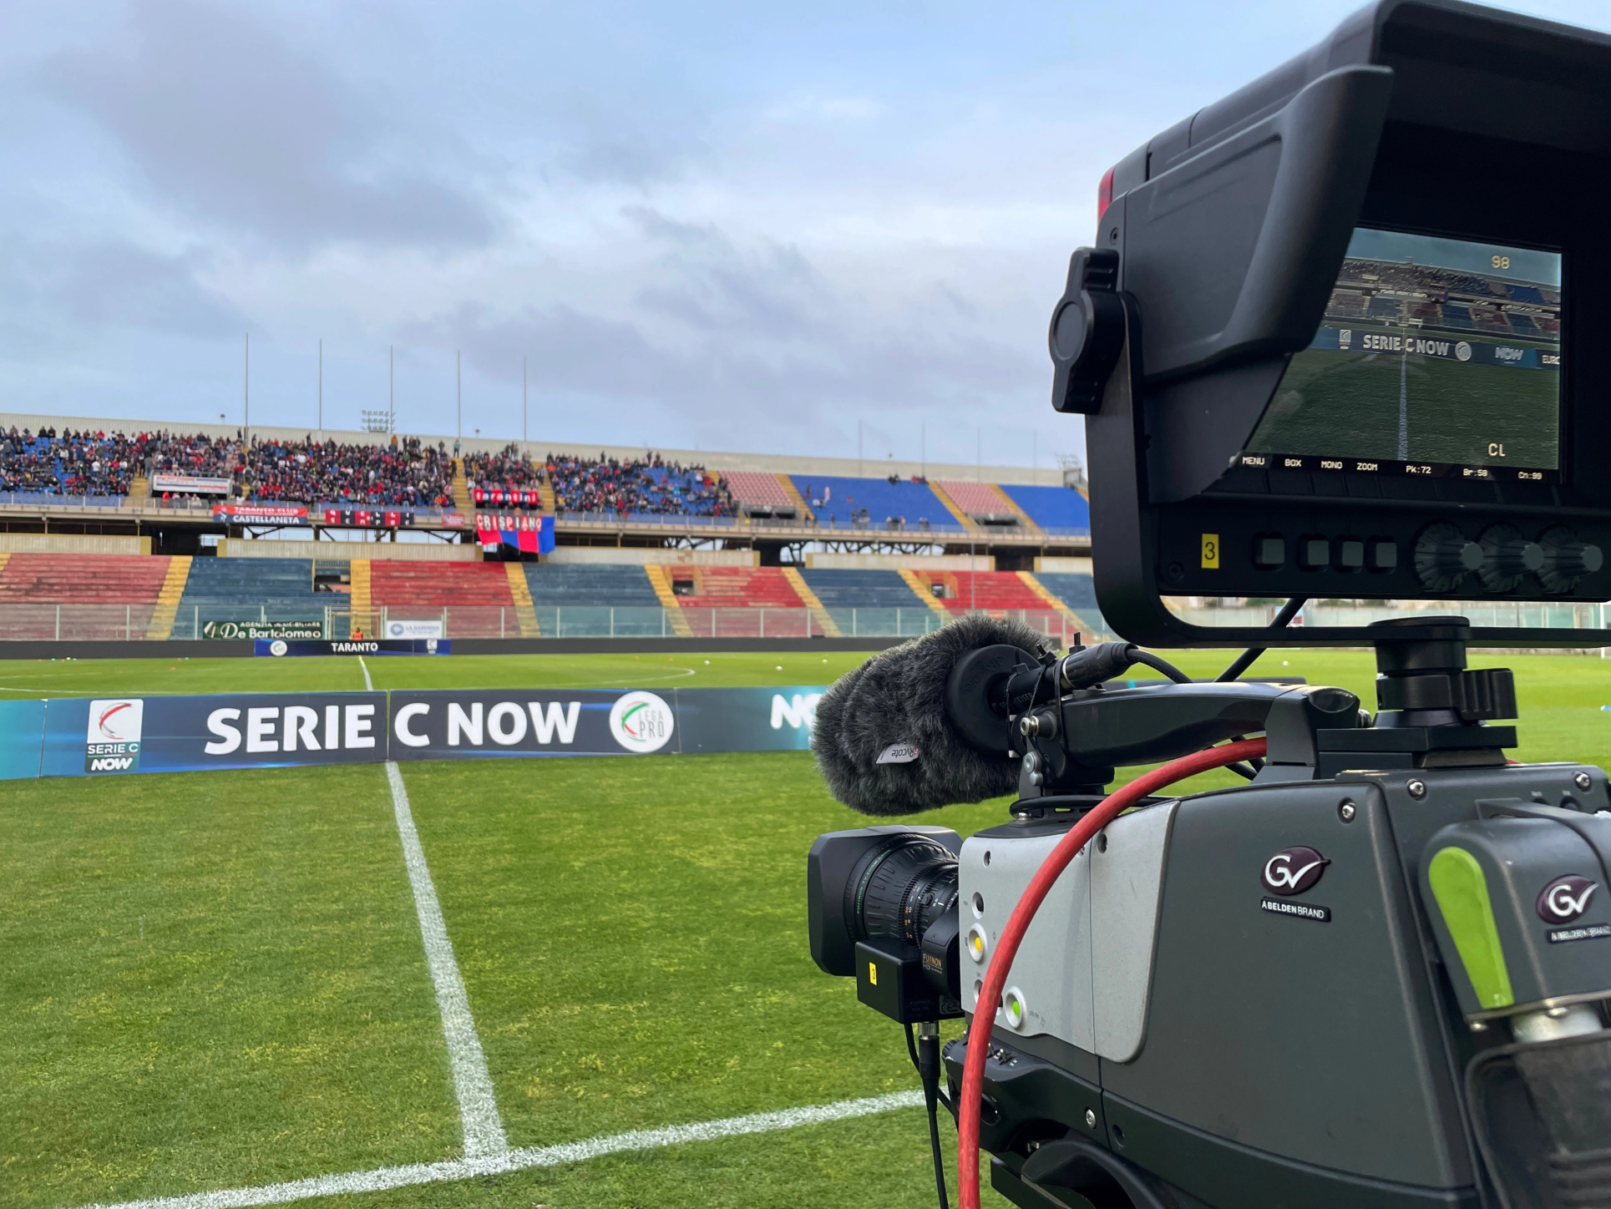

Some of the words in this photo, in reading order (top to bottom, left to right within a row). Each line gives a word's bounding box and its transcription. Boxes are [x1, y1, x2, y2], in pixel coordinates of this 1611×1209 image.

[1491, 255, 1510, 270] 98
[1363, 334, 1401, 351] SERIE
[1404, 338, 1415, 352] C
[1416, 339, 1450, 356] NOW
[1495, 346, 1524, 361] NOW
[1488, 443, 1506, 457] CL
[1242, 456, 1265, 466] MENU
[1284, 458, 1302, 467] BOX
[1321, 460, 1343, 470] MONO
[1357, 462, 1378, 472] ZOOM
[1406, 465, 1432, 475] Pk:72
[476, 492, 536, 503] tarantini
[232, 515, 300, 524] CASTELLANETA
[476, 514, 542, 531] CRISPIANO
[1203, 541, 1216, 560] 3
[220, 622, 246, 639] De
[249, 627, 321, 639] Bartolomeo
[331, 642, 378, 652] TARANTO
[638, 709, 664, 722] LEGA
[770, 693, 822, 730] NO
[204, 704, 376, 755] SERIE
[394, 702, 430, 747] C
[447, 701, 581, 746] NOW
[639, 721, 665, 739] PRO
[87, 743, 124, 754] SERIE
[125, 742, 139, 753] C
[90, 757, 133, 771] NOW
[1261, 900, 1268, 910] A
[1267, 901, 1297, 914] BELDEN
[1297, 906, 1325, 919] BRAND
[922, 953, 942, 968] FUJINON
